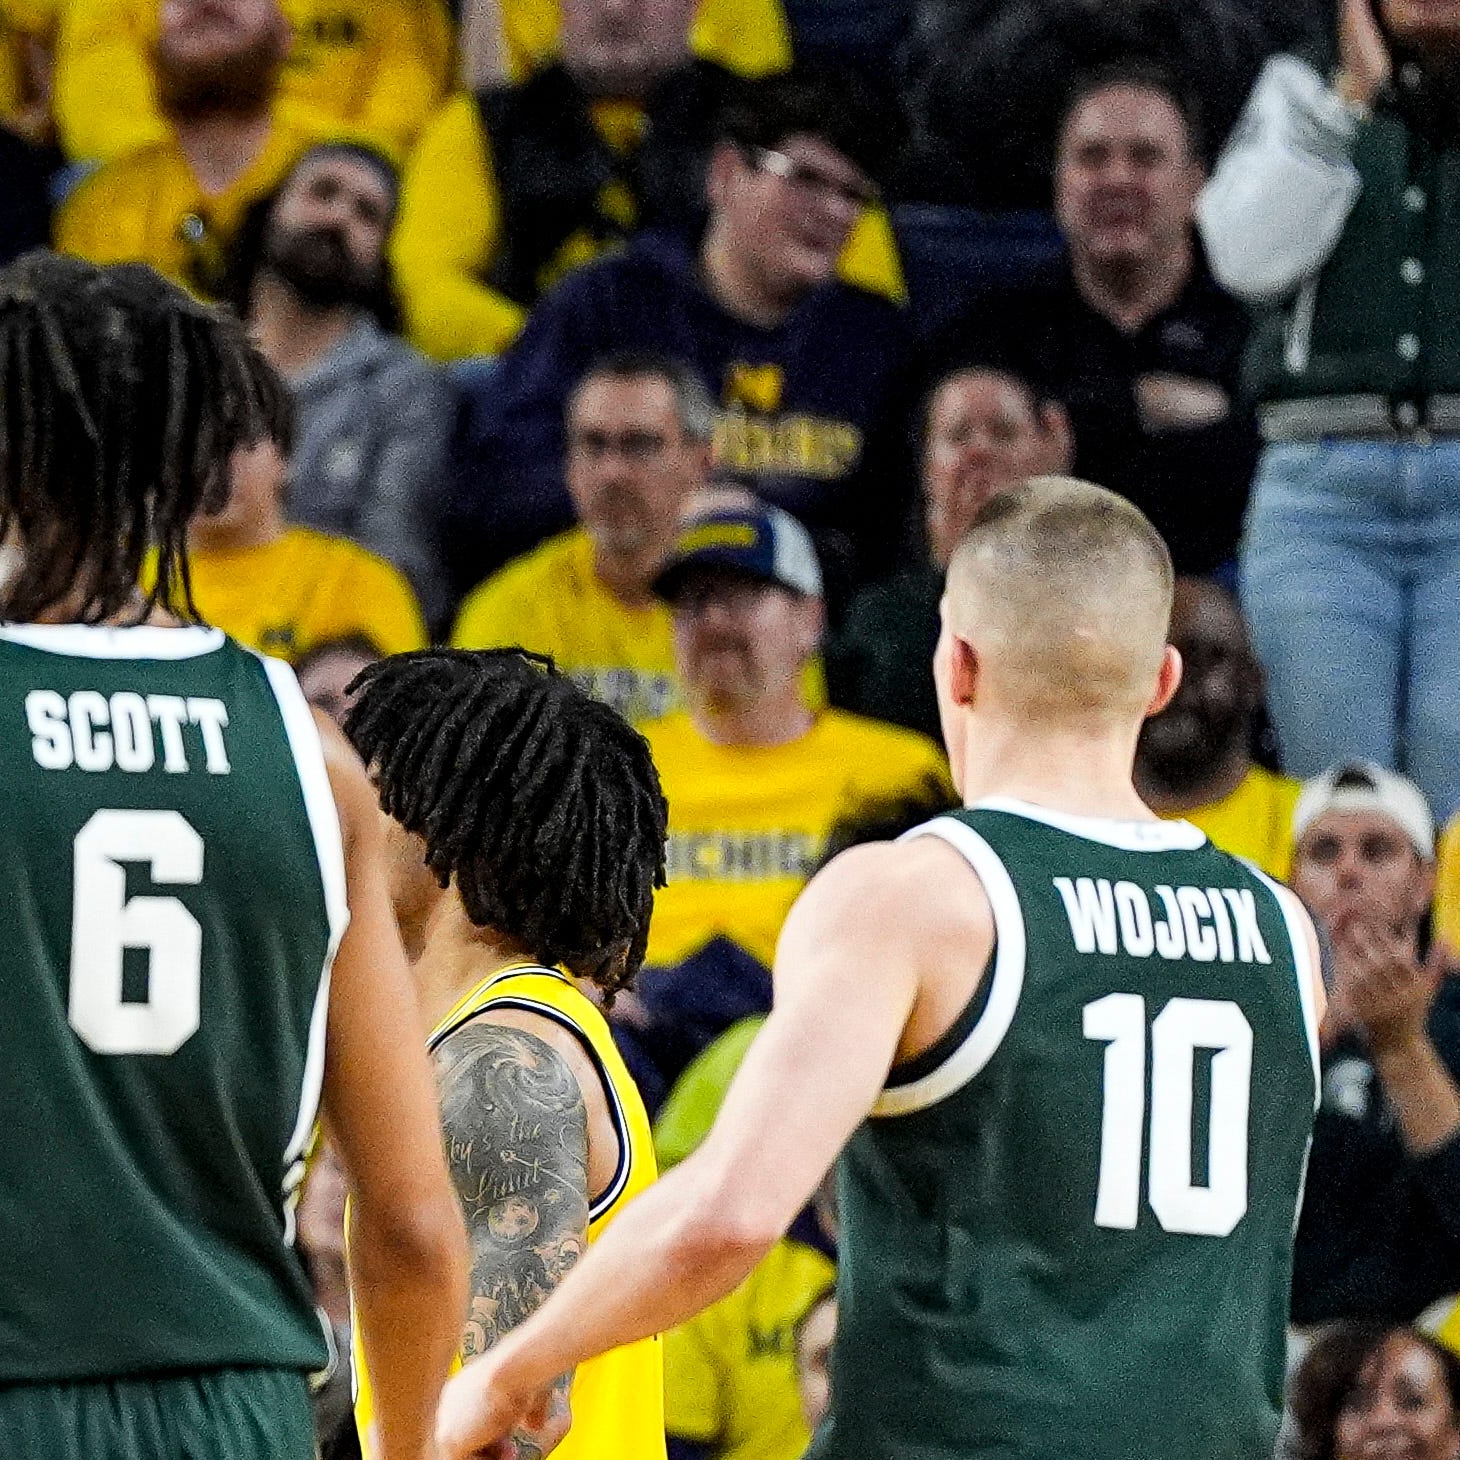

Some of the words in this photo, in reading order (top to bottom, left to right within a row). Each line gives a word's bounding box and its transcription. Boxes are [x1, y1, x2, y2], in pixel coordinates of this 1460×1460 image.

[24, 689, 233, 776] SCOTT
[66, 808, 206, 1056] 6
[1052, 876, 1273, 966] WOJCIK
[1082, 991, 1255, 1238] 10
